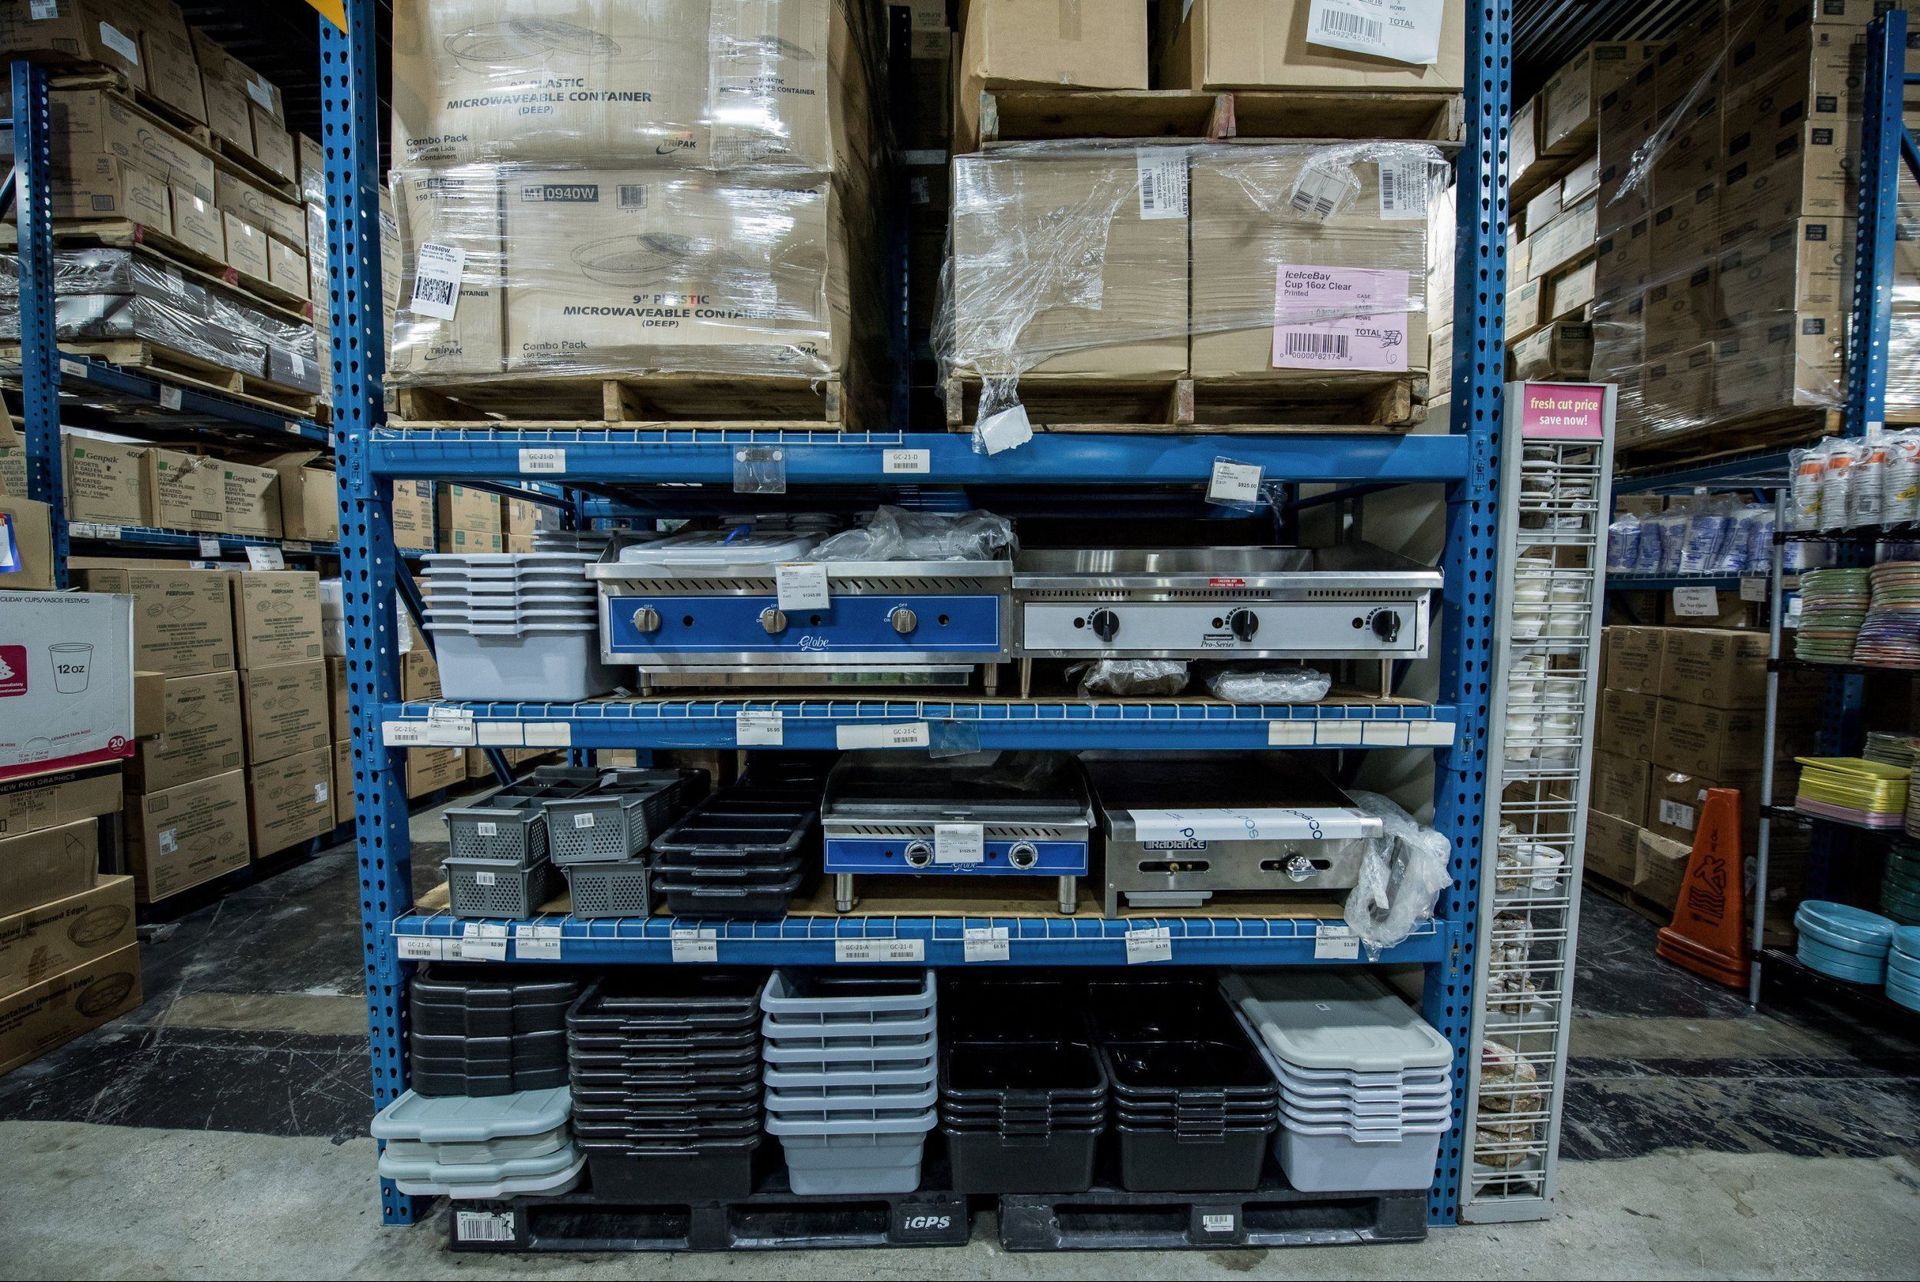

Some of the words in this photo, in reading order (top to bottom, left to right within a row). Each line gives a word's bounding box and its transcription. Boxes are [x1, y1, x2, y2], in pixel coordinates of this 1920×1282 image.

[1389, 17, 1415, 28] TOTAL
[777, 86, 815, 95] CONTAINER
[447, 92, 564, 110] MICROWAVEABLE
[569, 91, 652, 102] CONTAINER
[518, 105, 554, 115] (DEEP)
[406, 136, 441, 146] Combo
[443, 133, 468, 143] Pack
[547, 187, 595, 200] 0940W
[1285, 280, 1303, 289] Cup
[1306, 281, 1326, 290] 16oz
[1328, 282, 1352, 291] Clear
[460, 289, 489, 297] NTAINER
[1284, 289, 1309, 297] Printed
[632, 294, 649, 305] 9"
[563, 306, 690, 319] MICROWAVEABLE
[642, 319, 679, 329] (DEEP)
[1355, 328, 1381, 337] TOTAL
[523, 342, 559, 351] Combo
[561, 341, 588, 350] Pack
[1291, 352, 1315, 360] 00000
[1318, 352, 1341, 360] 82174
[1530, 397, 1555, 409] fresh
[1557, 399, 1572, 410] cut
[1574, 399, 1598, 413] price
[1539, 415, 1561, 425] save
[1563, 415, 1588, 425] now!
[86, 453, 119, 464] Genpak
[233, 475, 257, 483] Genpak
[24, 596, 63, 604] CUPS/VASOS
[64, 596, 90, 604] FESTIVOS
[798, 635, 830, 651] Globe
[1200, 640, 1235, 648] Pro-Series
[57, 664, 70, 674] 12
[71, 665, 85, 674] OZ
[110, 737, 124, 748] 20
[37, 774, 76, 785] GRAPHICS
[0, 926, 21, 938] tainer
[65, 903, 88, 917] Edge)
[0, 1002, 35, 1022] ontainer
[72, 974, 95, 989] Edge)
[904, 1216, 950, 1229] iGPS
